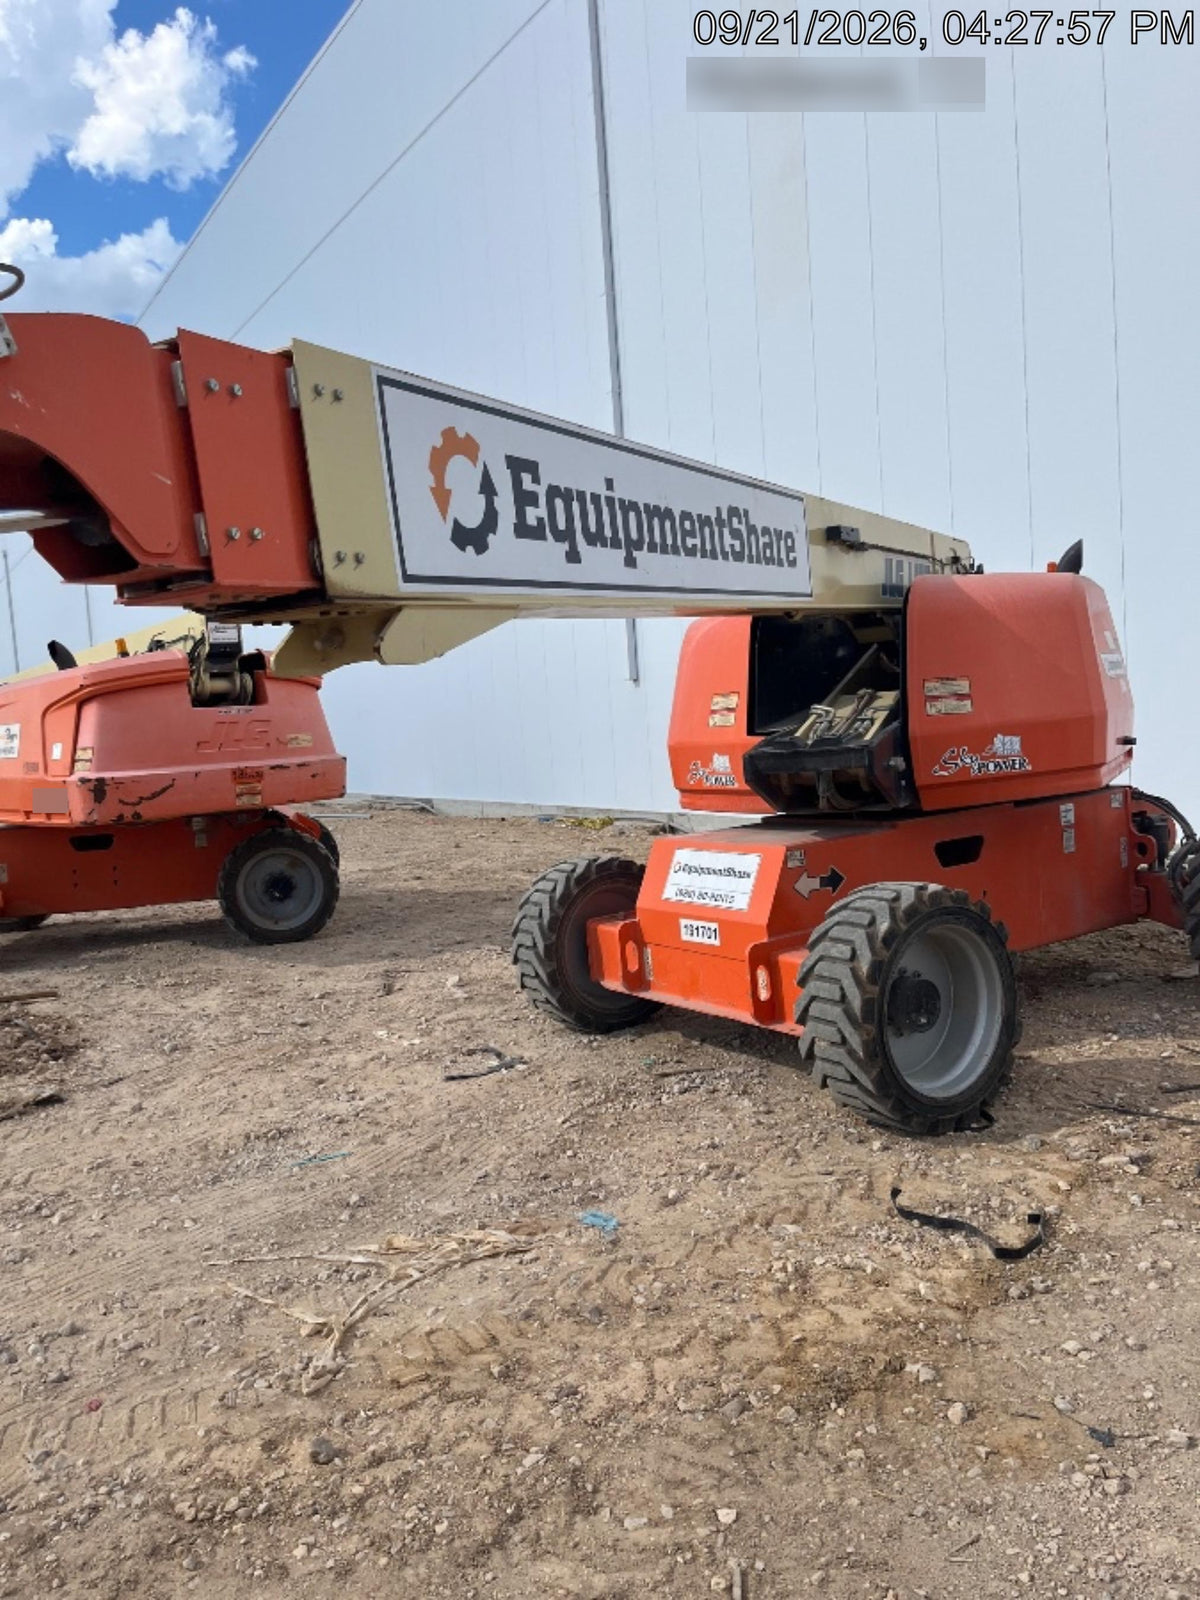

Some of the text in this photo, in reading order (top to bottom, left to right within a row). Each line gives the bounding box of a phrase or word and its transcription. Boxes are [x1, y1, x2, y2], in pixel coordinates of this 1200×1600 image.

[504, 454, 798, 569] EquipmentShare
[974, 756, 1031, 775] POWER
[683, 923, 718, 941] 191701
